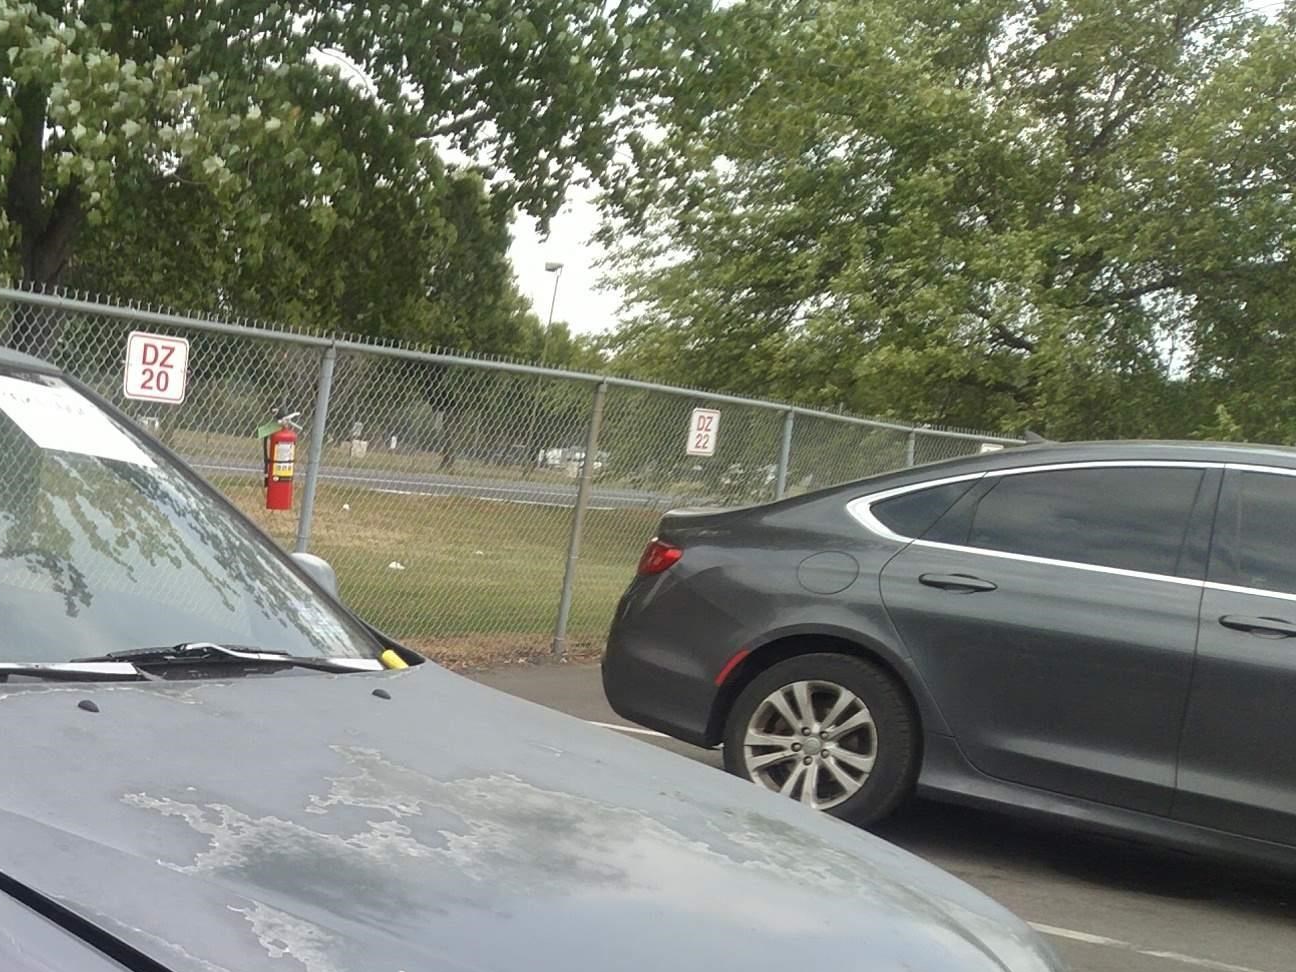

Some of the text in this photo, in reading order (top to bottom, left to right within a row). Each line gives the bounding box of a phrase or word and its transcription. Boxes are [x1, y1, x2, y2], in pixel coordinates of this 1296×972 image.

[142, 343, 175, 369] DZ
[141, 368, 169, 392] 20
[697, 415, 713, 431] DZ
[695, 433, 709, 449] 22
